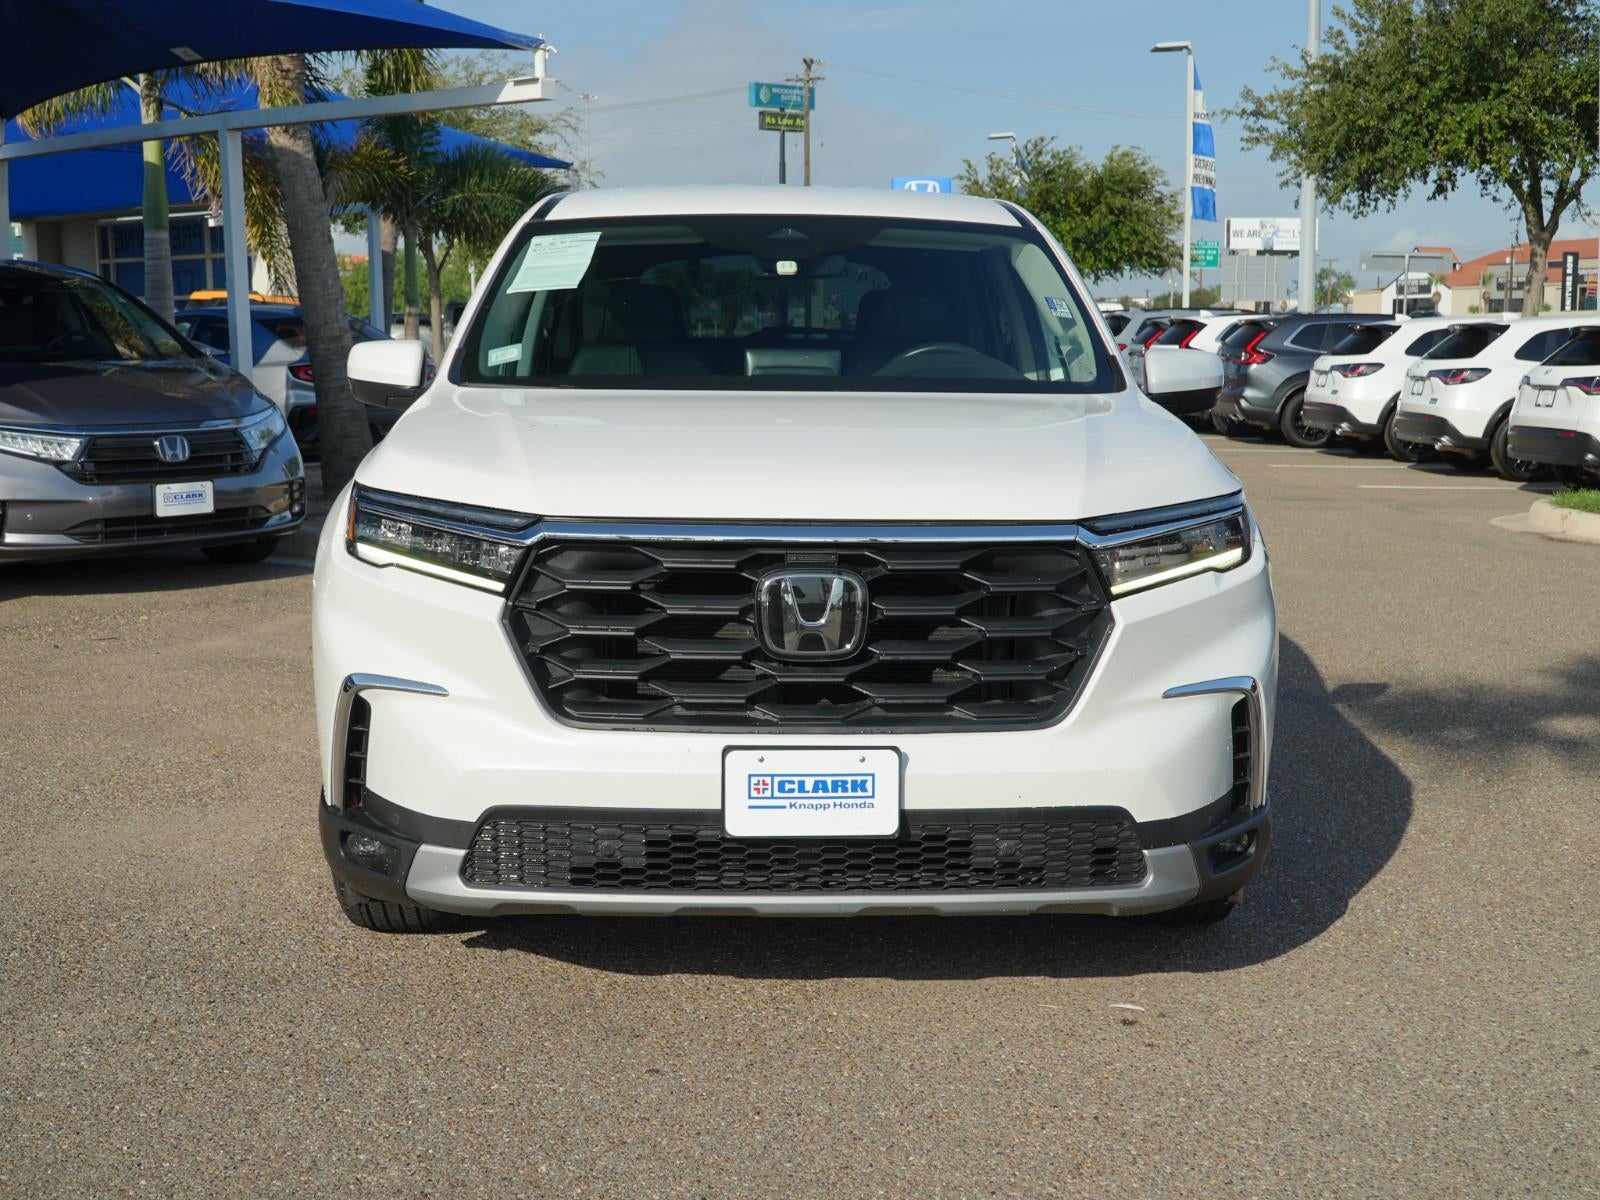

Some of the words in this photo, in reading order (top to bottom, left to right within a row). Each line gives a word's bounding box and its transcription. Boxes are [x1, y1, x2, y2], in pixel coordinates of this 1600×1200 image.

[1232, 229, 1243, 238] WE
[1246, 229, 1262, 238] ARE
[173, 492, 204, 500] CLARK
[777, 779, 869, 794] CLARK
[789, 801, 831, 810] Knapp
[833, 801, 875, 810] Honda
